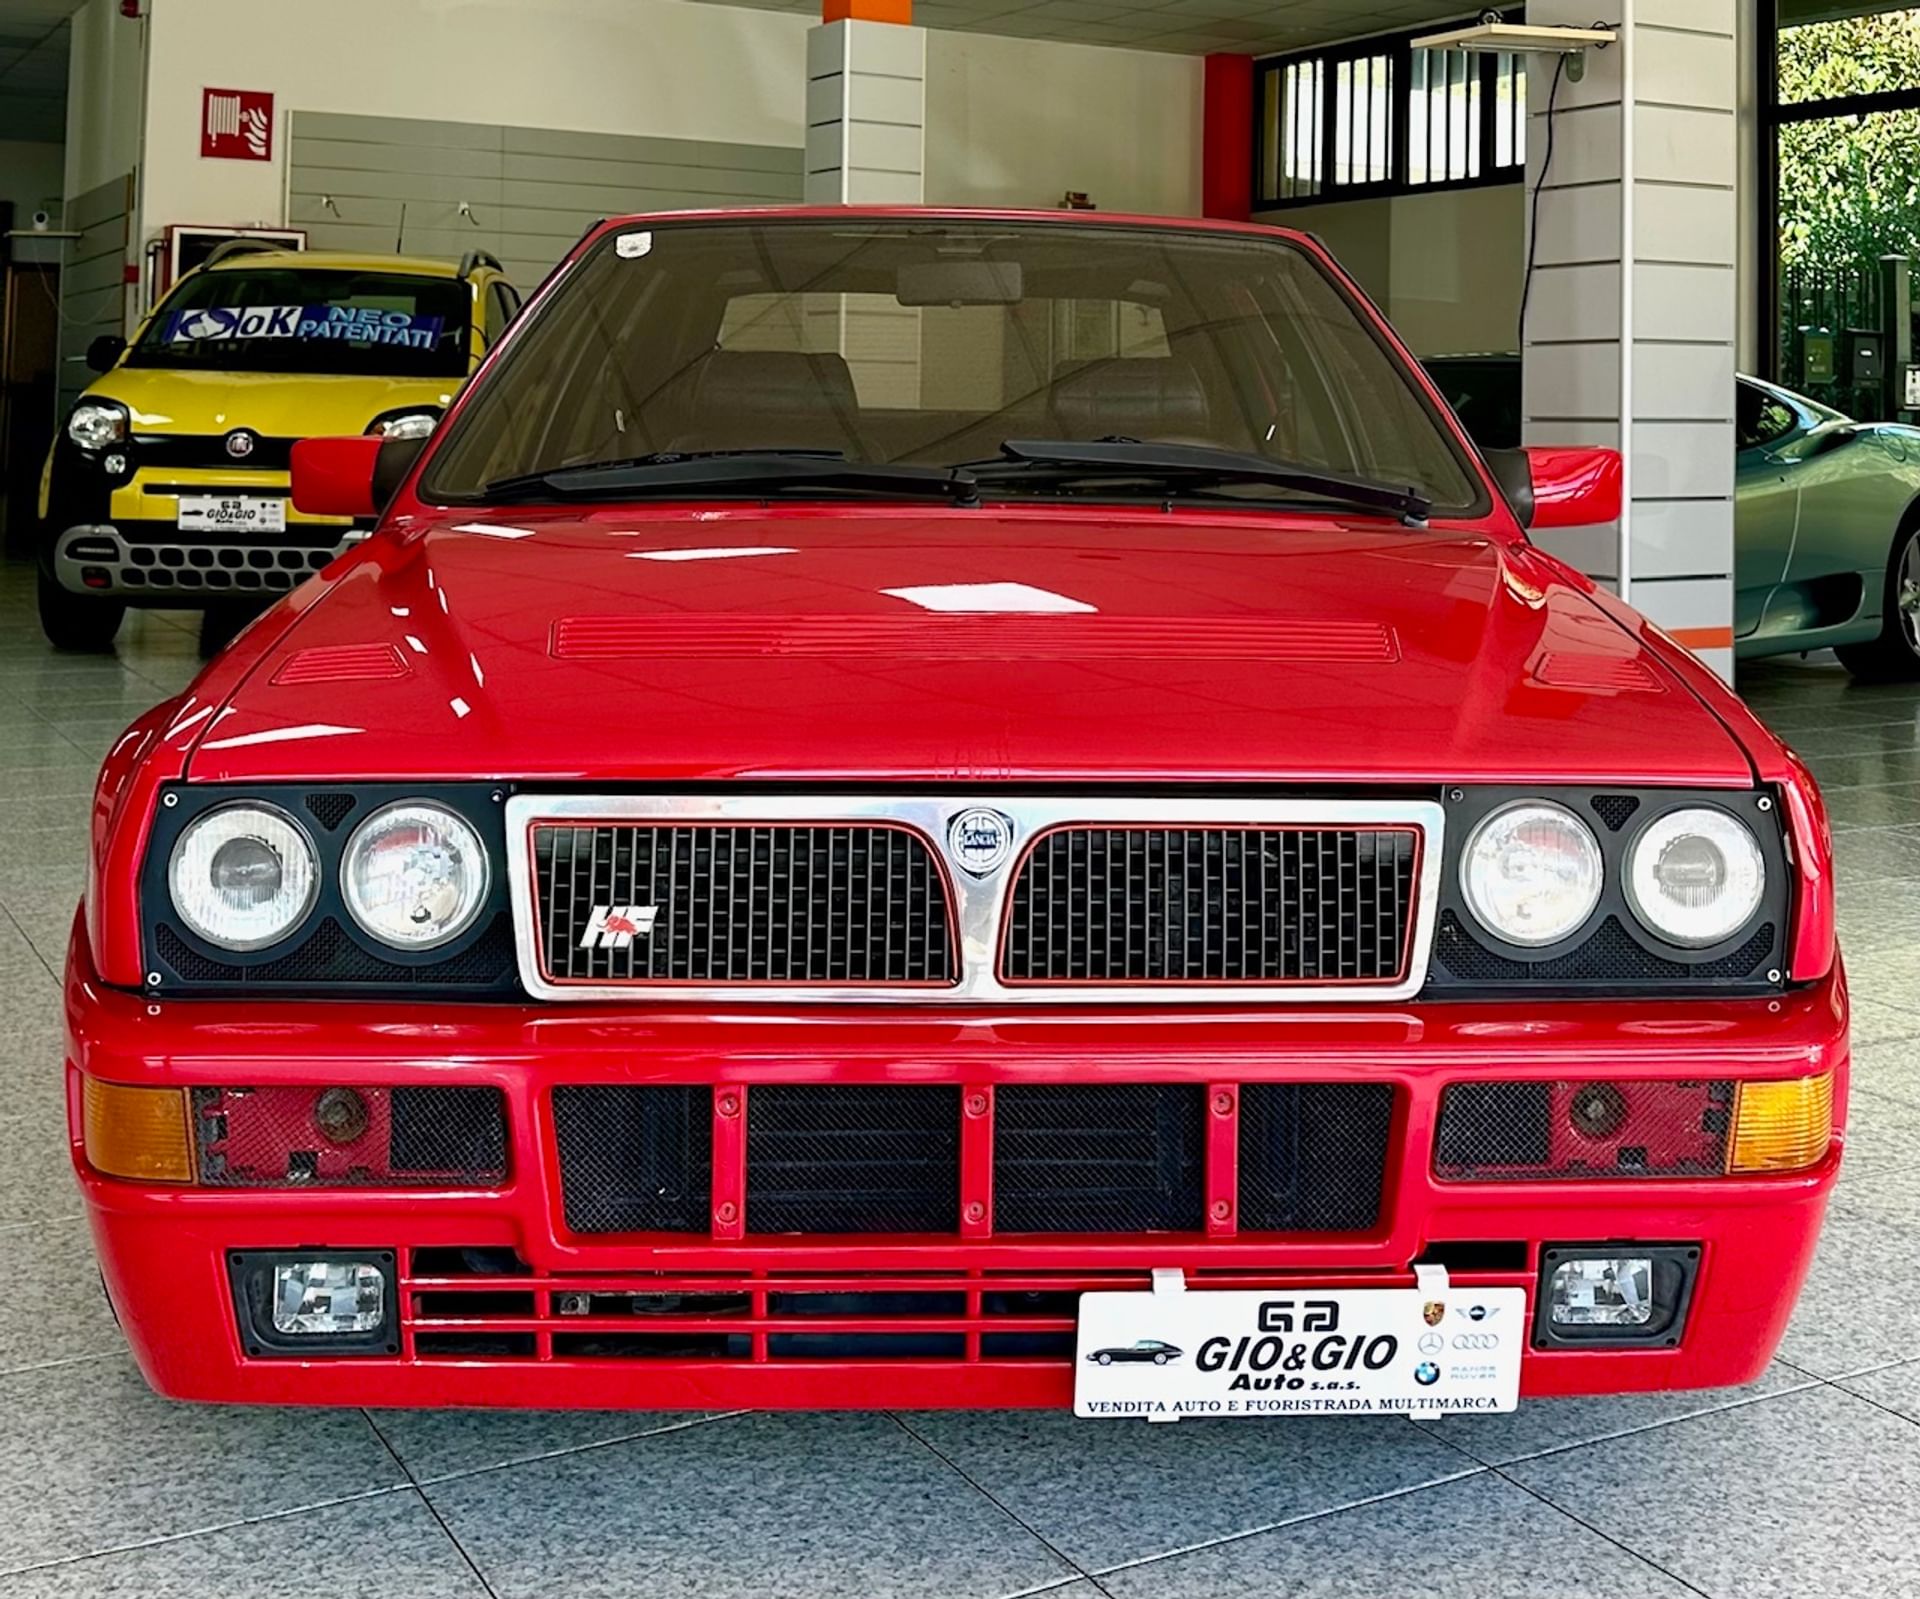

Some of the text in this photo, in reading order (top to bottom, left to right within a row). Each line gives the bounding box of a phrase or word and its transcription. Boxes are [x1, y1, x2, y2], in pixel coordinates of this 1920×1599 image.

[328, 306, 412, 327] NEO
[297, 319, 433, 349] PATENTATI
[1195, 1334, 1398, 1372] GIO&GIO
[1228, 1373, 1361, 1391] Auto s.a.s.
[1087, 1397, 1499, 1412] VENDITA AUTO E FUORISTRADA MULTIMARCA
